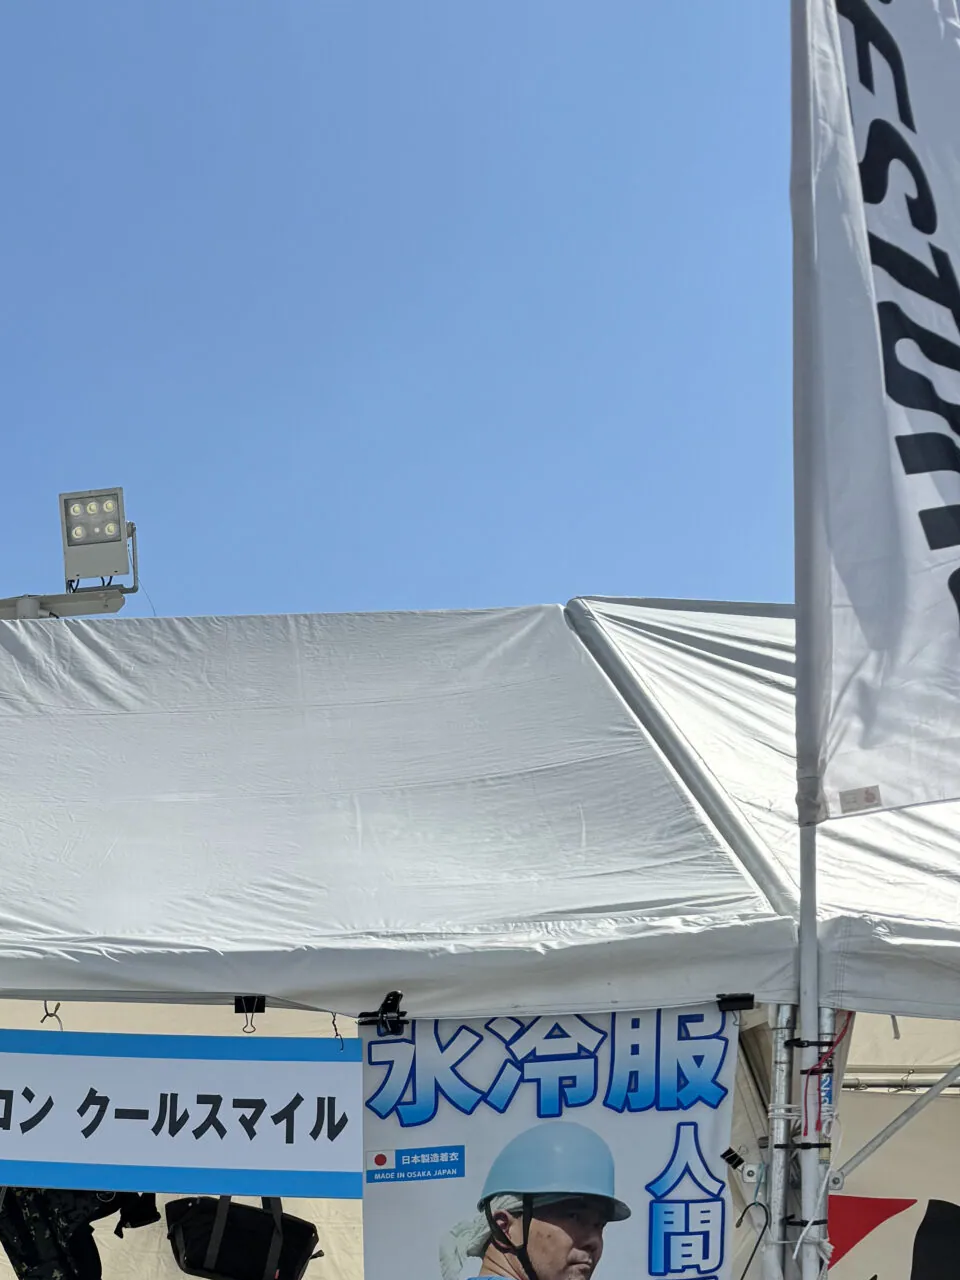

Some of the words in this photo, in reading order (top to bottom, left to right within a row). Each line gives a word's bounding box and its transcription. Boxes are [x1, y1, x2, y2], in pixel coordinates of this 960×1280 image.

[76, 1087, 348, 1144] クールスマイル
[374, 1172, 395, 1180] MADE
[407, 1170, 431, 1178] OSAKA
